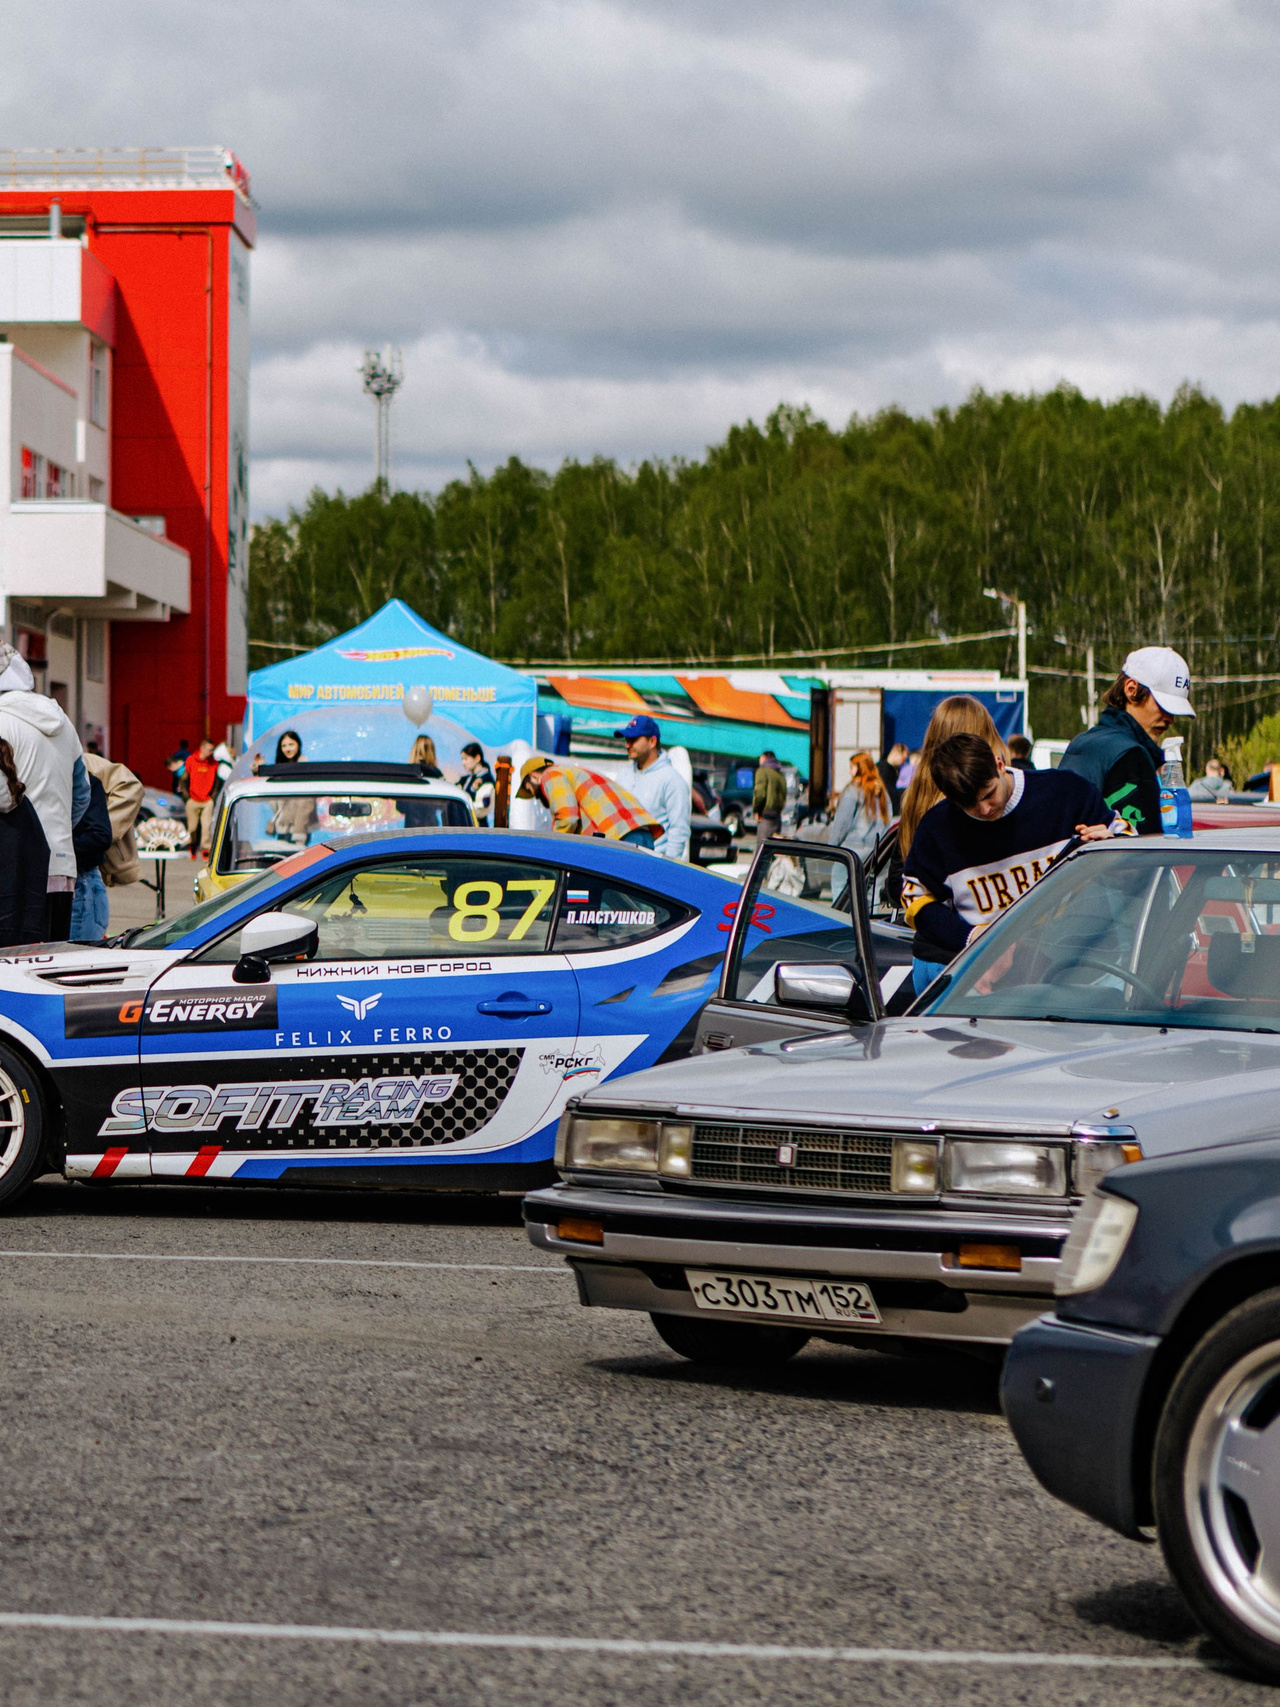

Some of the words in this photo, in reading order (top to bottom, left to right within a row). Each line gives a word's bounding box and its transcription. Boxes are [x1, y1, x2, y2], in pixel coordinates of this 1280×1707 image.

[288, 684, 314, 700] МИР
[316, 683, 405, 701] АВТОМОБИЛЕЙ
[429, 686, 497, 702] ПОМЕНЬШЕ
[1175, 676, 1191, 690] EA
[448, 879, 556, 942] 87
[566, 910, 656, 925] П.ПАСТУШКОВ
[296, 965, 379, 977] НИЖНИЙ
[387, 962, 493, 974] НОВГОРОД
[179, 996, 232, 1005] МОТОРНОЕ
[275, 1030, 352, 1046] FELIX
[373, 1026, 452, 1042] FERRO
[555, 1057, 593, 1068] РСКГ
[323, 1078, 454, 1103] RACING
[98, 1083, 326, 1136] SOFIT
[319, 1100, 421, 1122] TEAM
[820, 1284, 868, 1310] 152
[835, 1307, 859, 1318] RUS
